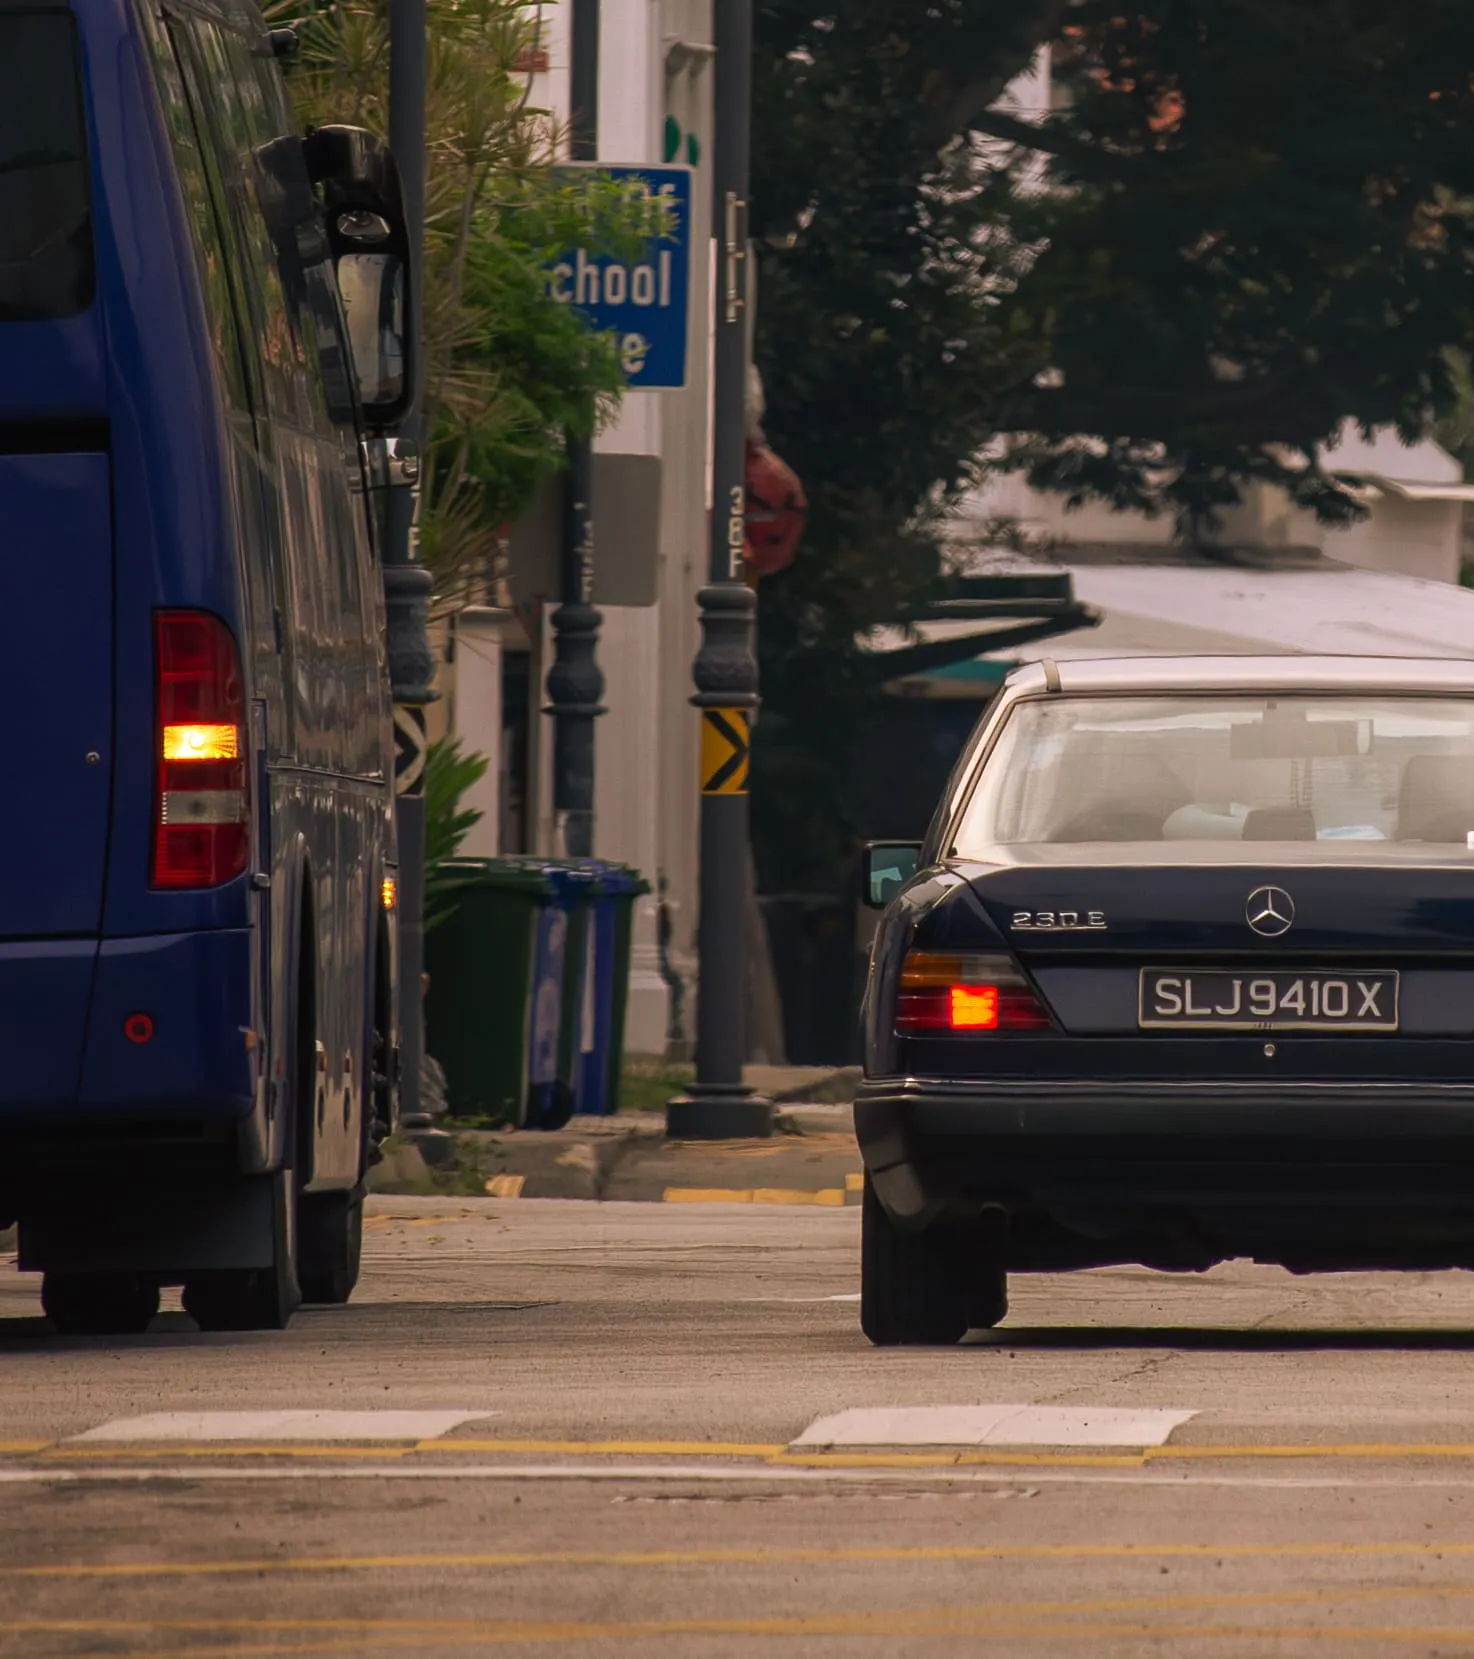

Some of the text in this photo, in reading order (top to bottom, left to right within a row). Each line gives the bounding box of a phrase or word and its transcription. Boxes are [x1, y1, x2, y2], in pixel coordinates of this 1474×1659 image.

[546, 249, 671, 306] chool
[1012, 911, 1105, 927] 230 E
[1155, 978, 1383, 1017] SLJ9410X
